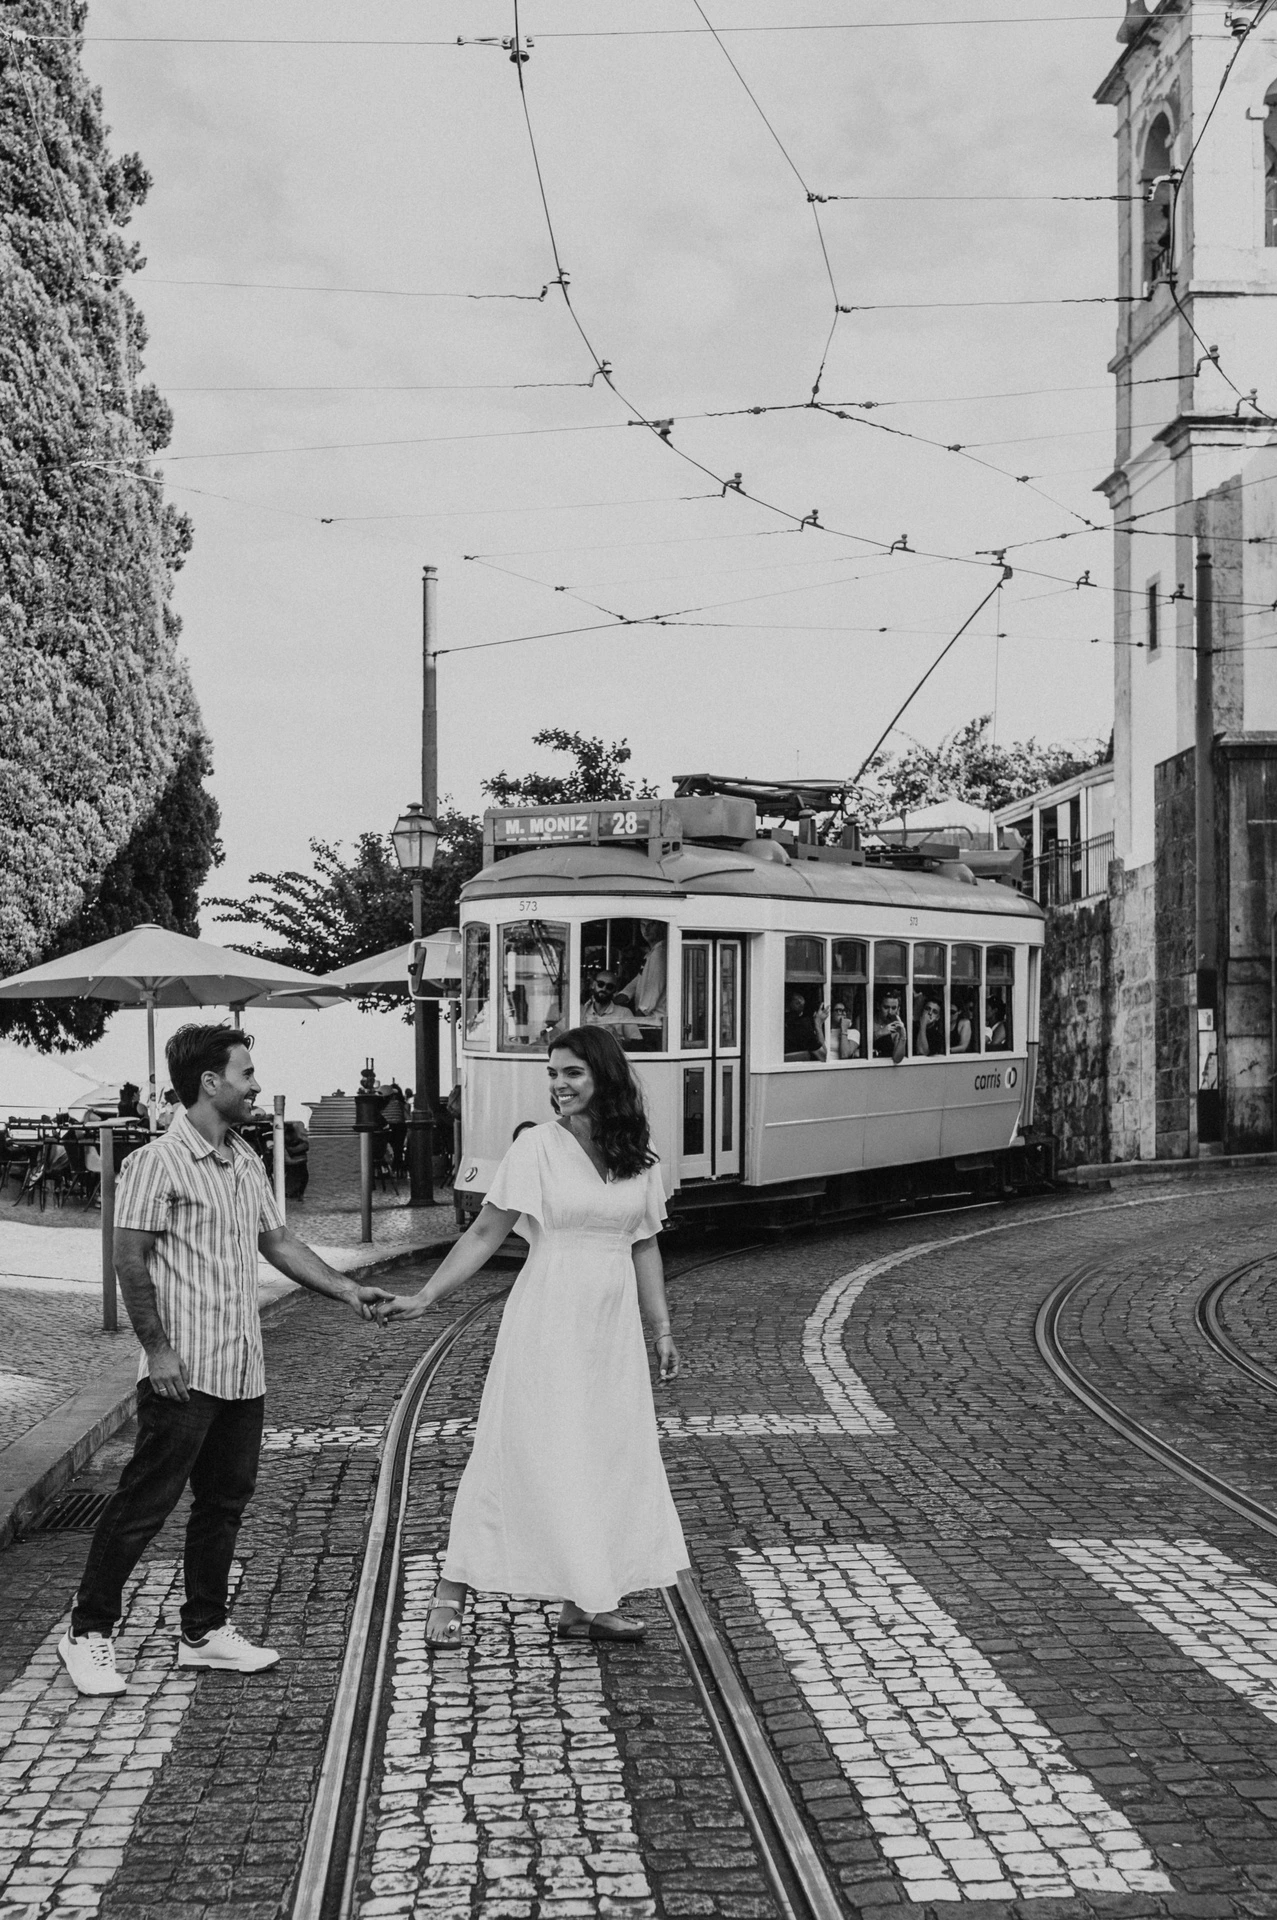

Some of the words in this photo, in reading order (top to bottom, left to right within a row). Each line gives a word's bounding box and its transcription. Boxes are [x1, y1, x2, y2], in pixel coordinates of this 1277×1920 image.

[506, 819, 525, 835] M.
[530, 816, 588, 833] MONIZ
[612, 811, 638, 835] 28
[519, 900, 538, 912] 573
[974, 1067, 1001, 1090] carris
